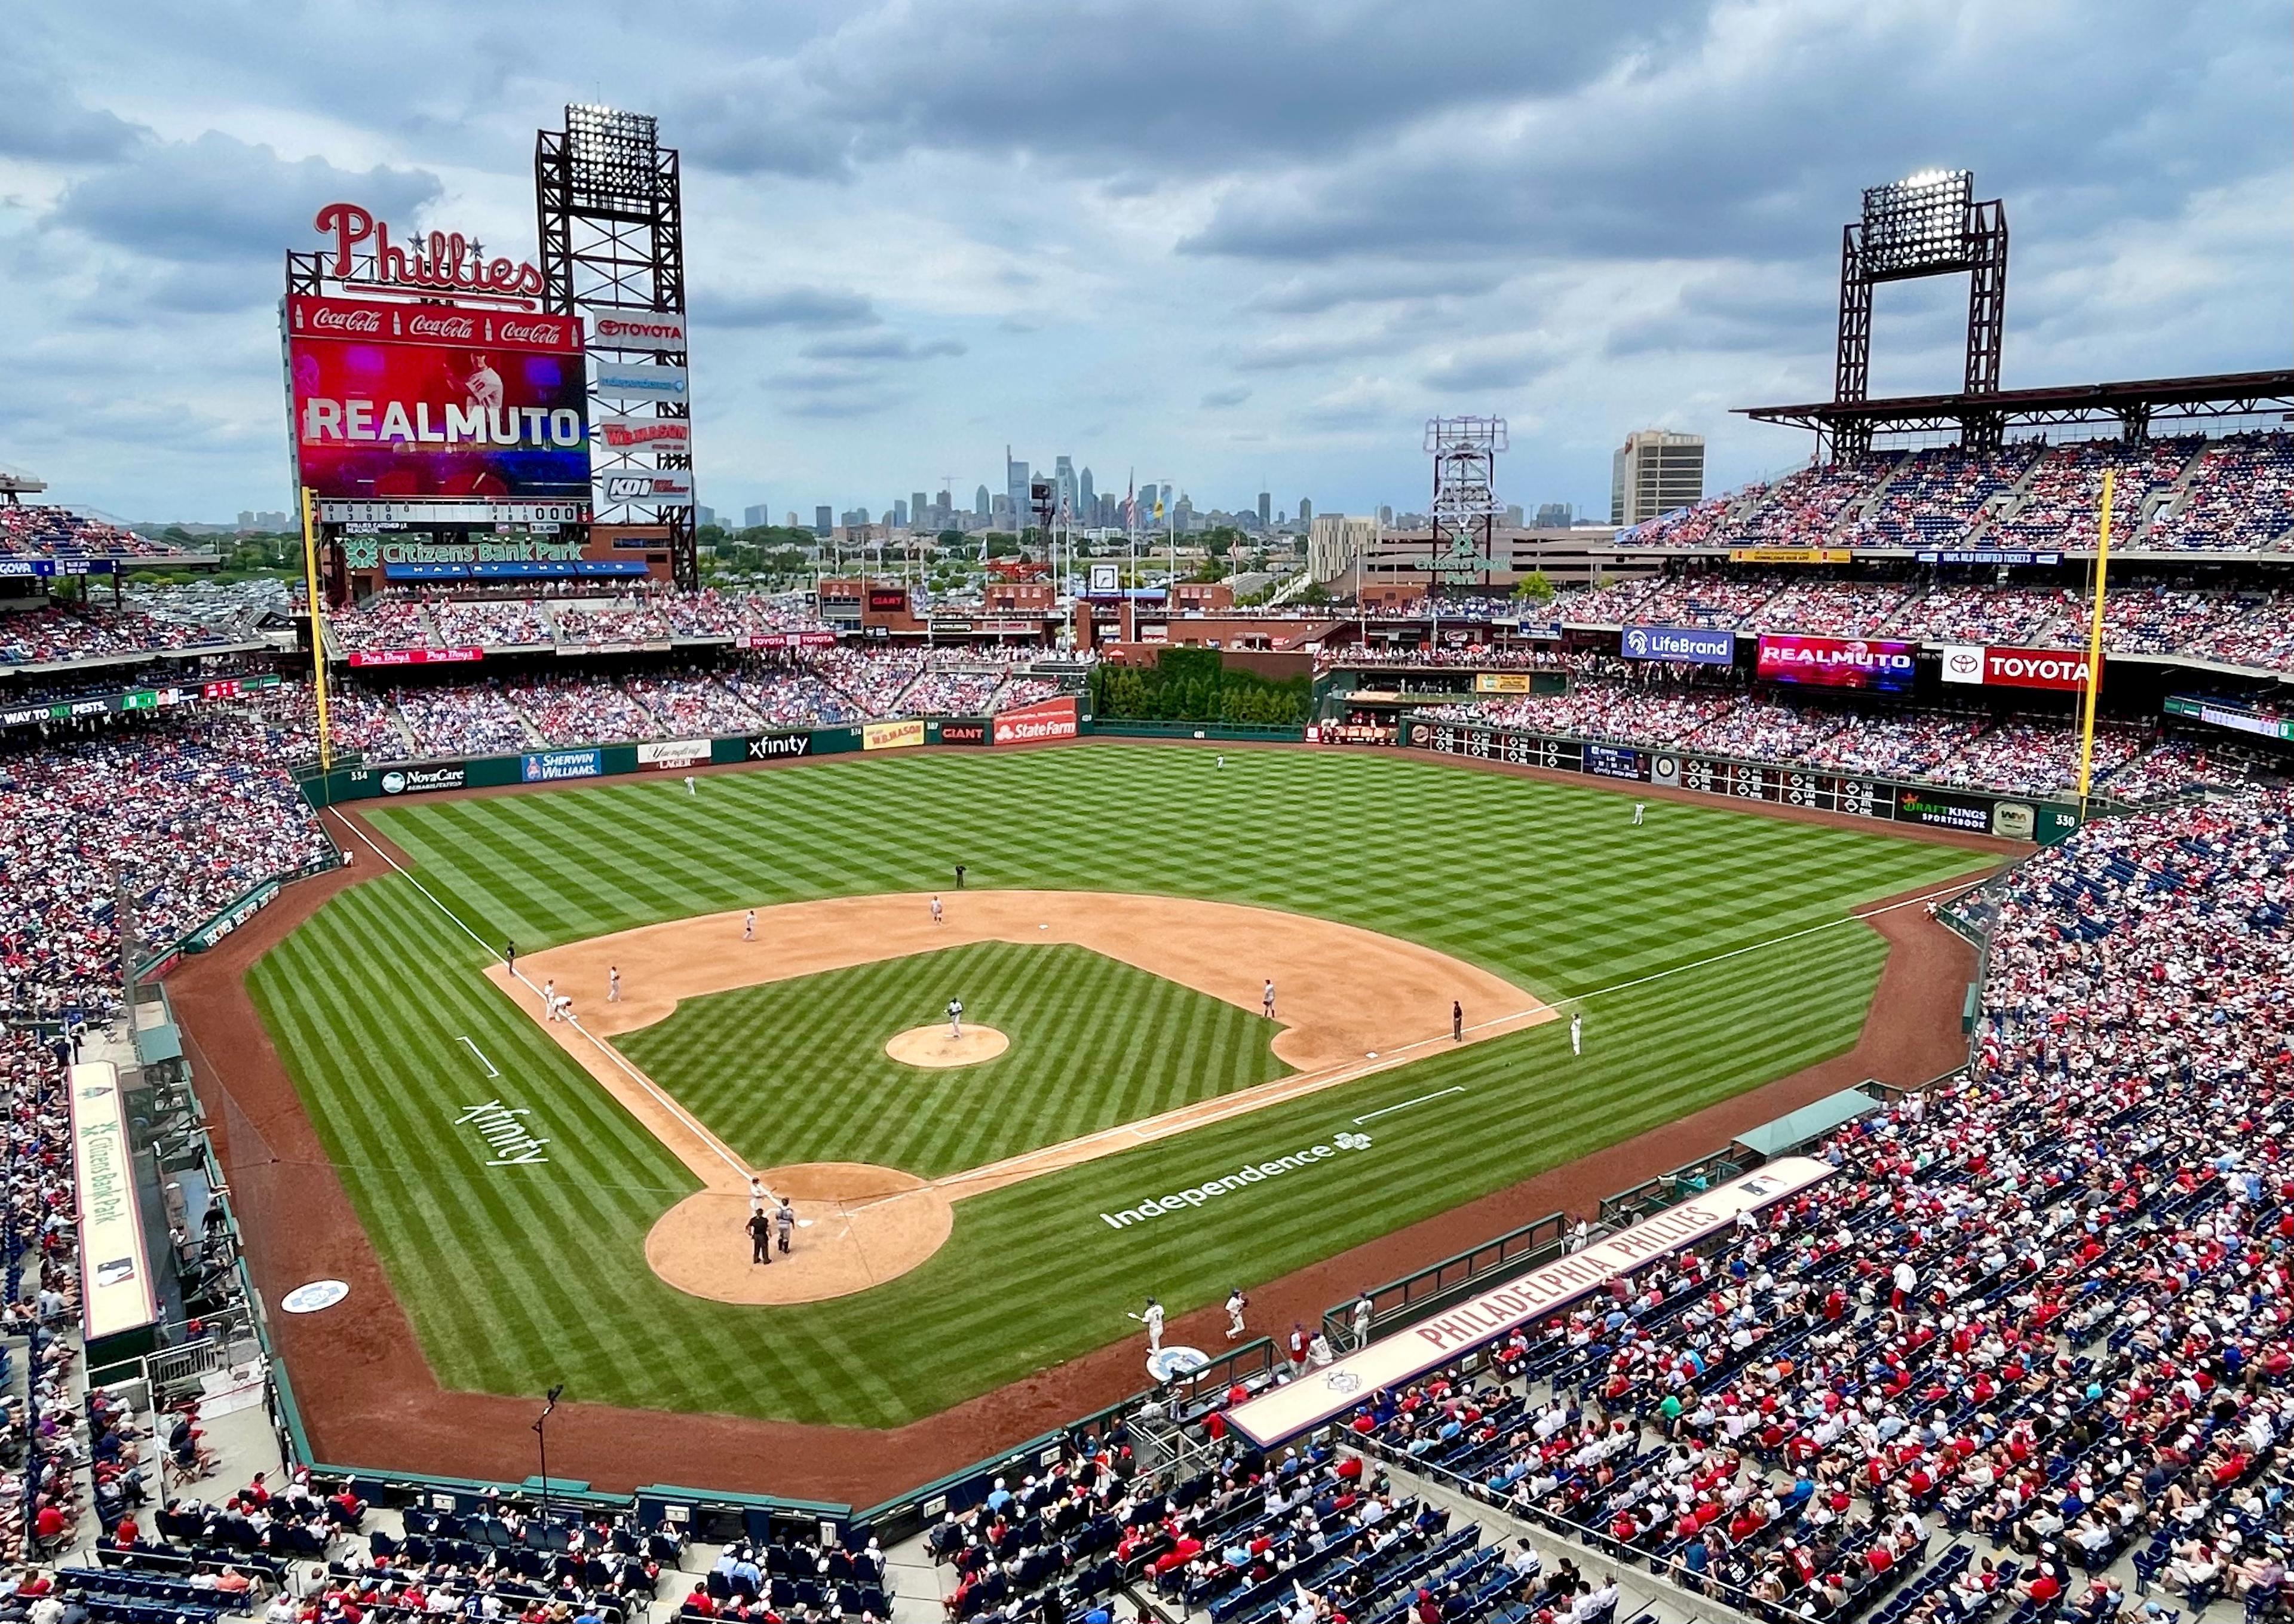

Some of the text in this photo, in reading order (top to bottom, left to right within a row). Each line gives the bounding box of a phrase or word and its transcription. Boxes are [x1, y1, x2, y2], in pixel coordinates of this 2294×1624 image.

[314, 202, 545, 294] Phillies
[619, 323, 682, 339] TOYOTA
[306, 397, 580, 447] REALMUTO
[536, 508, 574, 520] 0 0 0
[384, 541, 583, 563] Citizens Bank Park
[1652, 636, 1727, 655] LifeBrand
[1764, 647, 1910, 668] REALMUTO
[1989, 657, 2089, 681] TOYOTA
[4, 711, 31, 724] WAY
[32, 708, 50, 720] TO
[942, 728, 983, 739] GIANT
[749, 736, 808, 759] xfinity
[543, 753, 594, 766] SHERWIN
[406, 769, 464, 784] NovaCare
[1903, 803, 1987, 819] DRAFTKINGS
[1922, 813, 1985, 829] SPORTSBOOK
[2056, 815, 2075, 827] 330
[455, 1099, 550, 1166] xfinity
[88, 1137, 125, 1226] Citizens Bank Park
[1100, 1145, 1335, 1229] Independence
[1416, 1207, 1719, 1350] PHILADELPHIA PHILLIES
